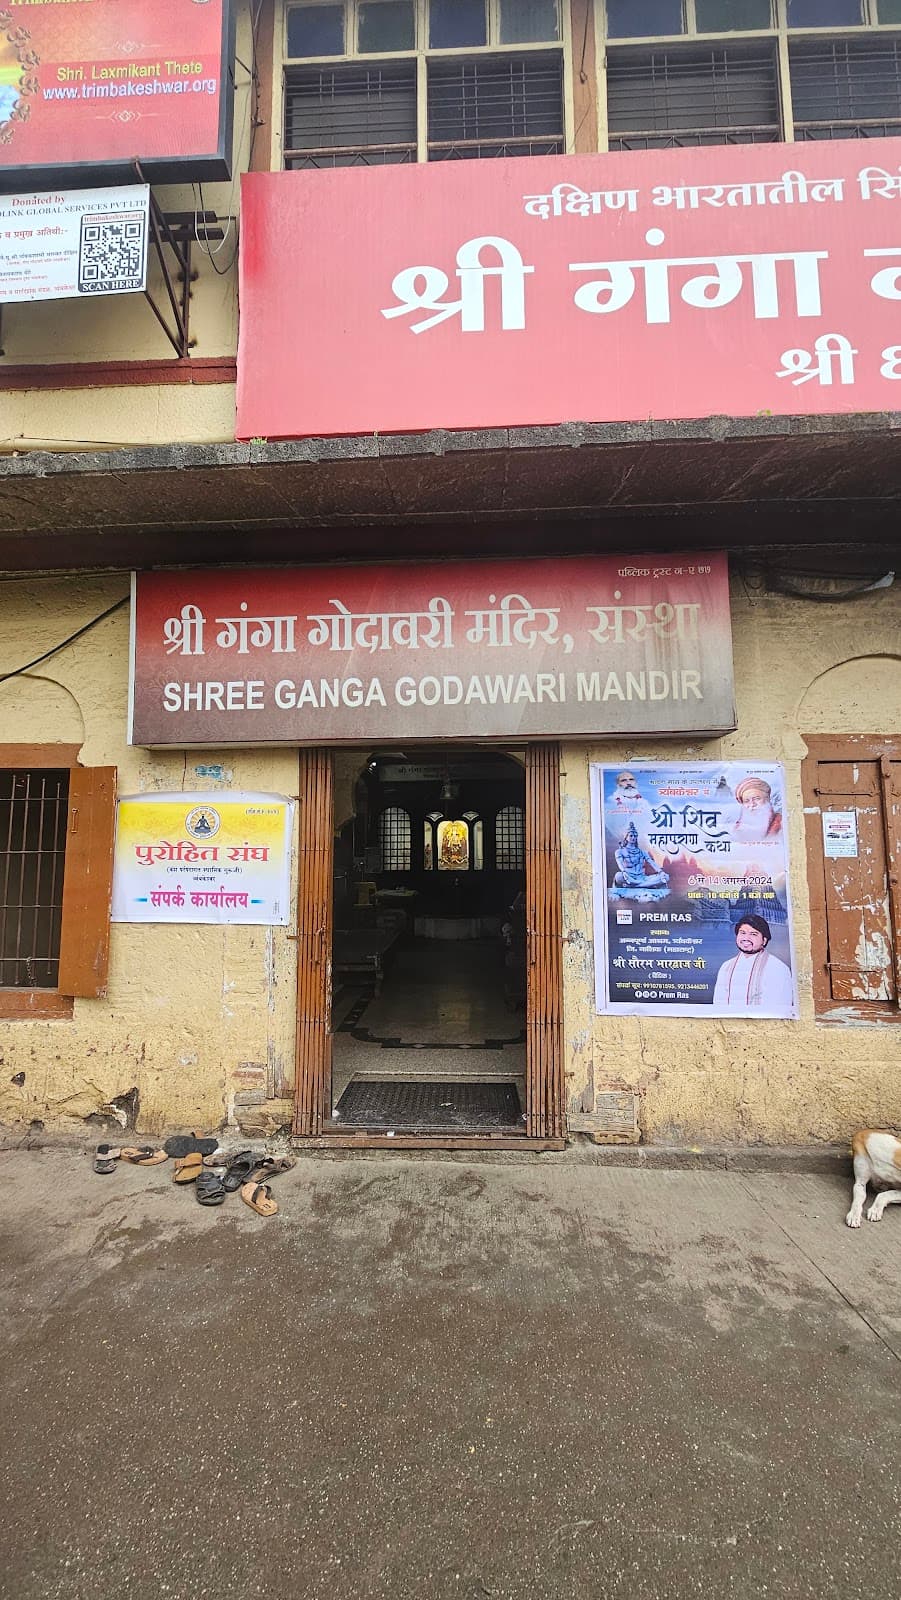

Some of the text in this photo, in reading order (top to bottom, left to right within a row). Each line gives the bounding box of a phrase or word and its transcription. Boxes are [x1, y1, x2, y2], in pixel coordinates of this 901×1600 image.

[57, 61, 203, 82] Shri. Laxmikant Thete
[43, 79, 217, 100] www.trimbakeshwar.org
[12, 195, 66, 207] Donated by
[523, 183, 639, 220] दक्षिण
[652, 170, 844, 211] भारतातील
[26, 205, 63, 216] GLOBAL
[64, 202, 108, 213] SERVICES
[110, 200, 128, 209] PVT
[129, 199, 147, 208] LTD
[82, 281, 109, 292] SCAN
[111, 279, 140, 290] HERE
[380, 235, 535, 335] श्री
[568, 228, 829, 325] गंगा
[776, 333, 859, 387] श्री
[163, 590, 701, 655] श्री गंगा गोदावरी मंदिर, संस्था
[163, 670, 704, 712] SHREE GANGA GODAWARI MANDIR
[650, 804, 728, 837] श्री शिव
[135, 840, 270, 866] पुरोहित संघ
[704, 840, 731, 853] कथा
[688, 875, 696, 886] 6
[708, 875, 720, 885] 14
[749, 875, 773, 885] 2024
[150, 885, 185, 907] संपर्क
[190, 885, 249, 908] कार्यालय
[640, 913, 668, 922] PREM
[671, 913, 692, 922] RAS
[612, 956, 626, 969] श्री
[693, 957, 706, 969] जी
[658, 991, 690, 999] Prem Ras
